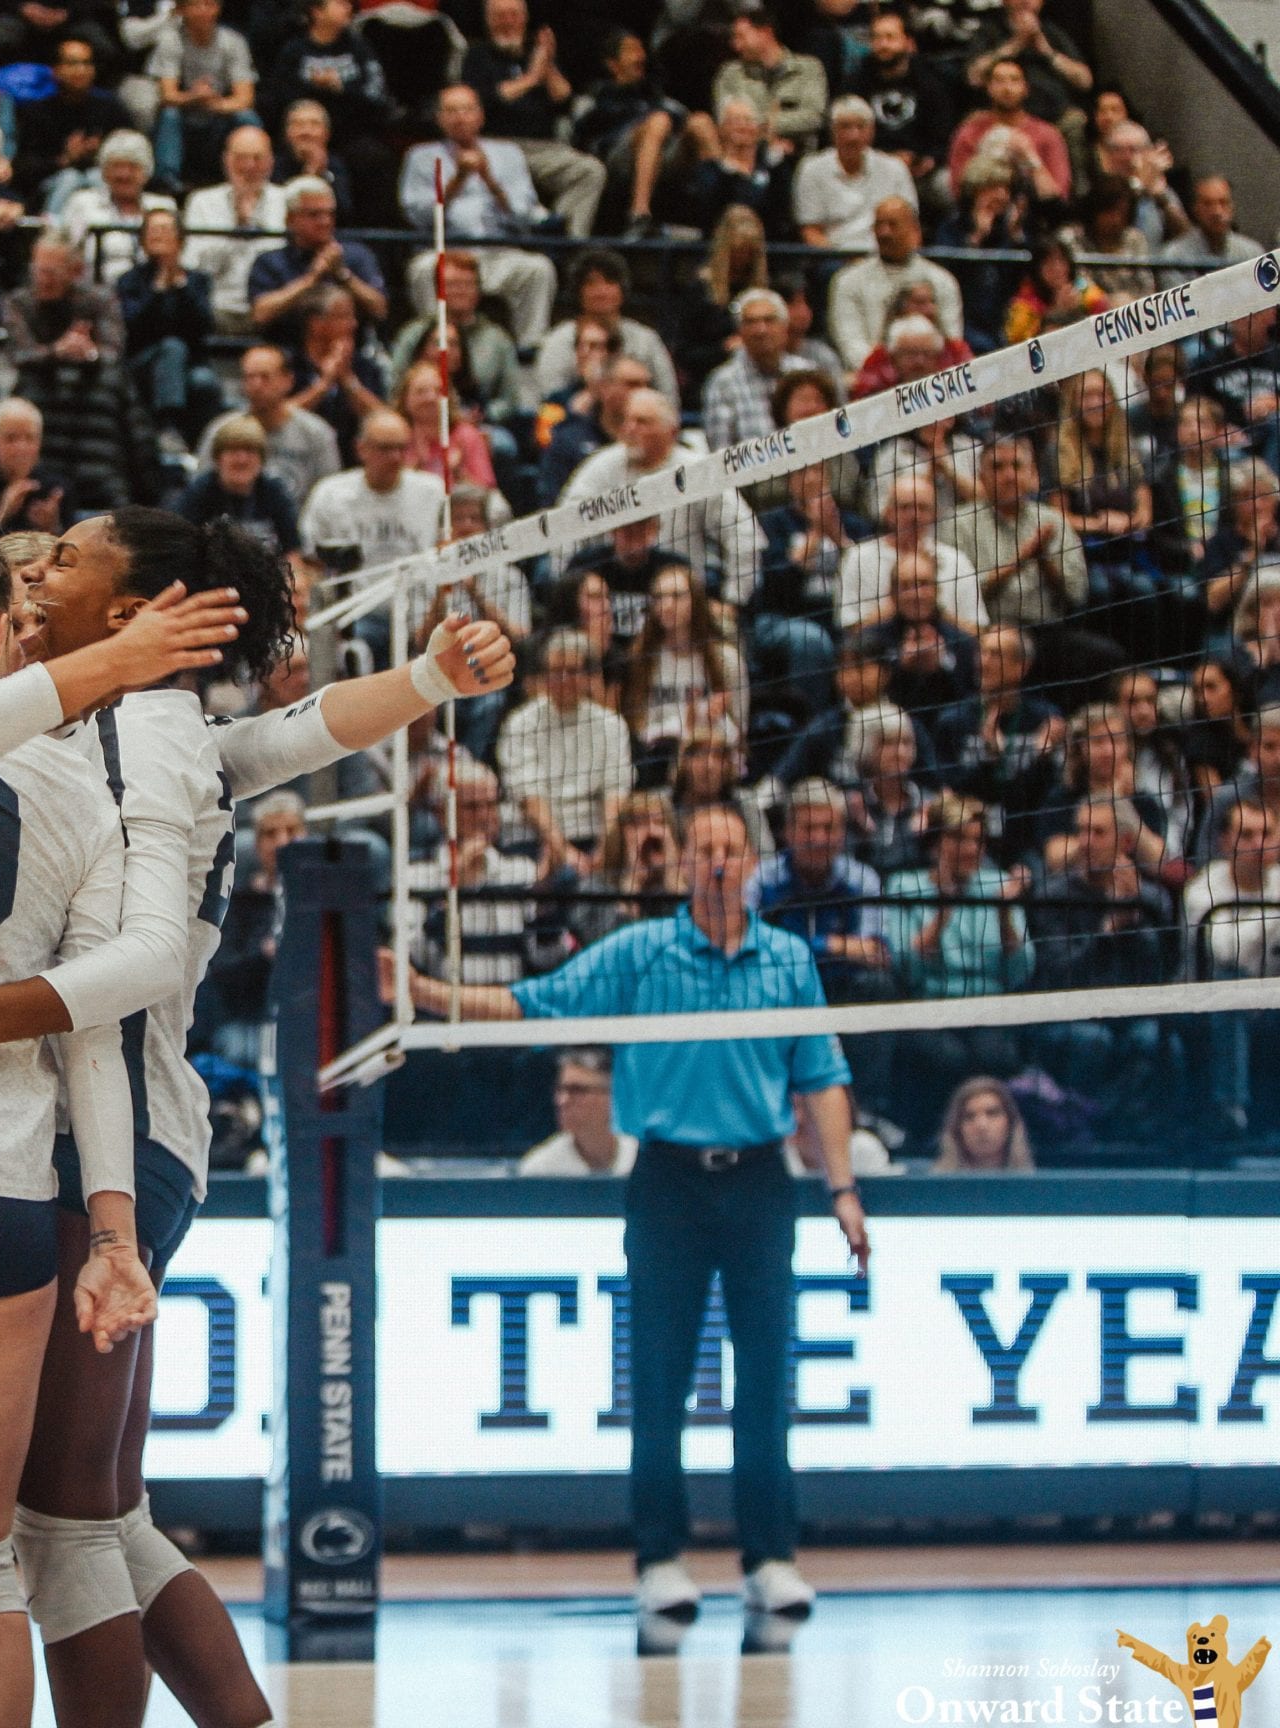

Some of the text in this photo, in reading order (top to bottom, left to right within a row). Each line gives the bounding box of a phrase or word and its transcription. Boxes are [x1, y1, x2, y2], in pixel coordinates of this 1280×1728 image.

[1094, 283, 1196, 349] PENN STATE
[894, 363, 977, 418] PENN STATE
[722, 428, 796, 475] PENN STATE
[321, 1282, 354, 1481] PENN STATE
